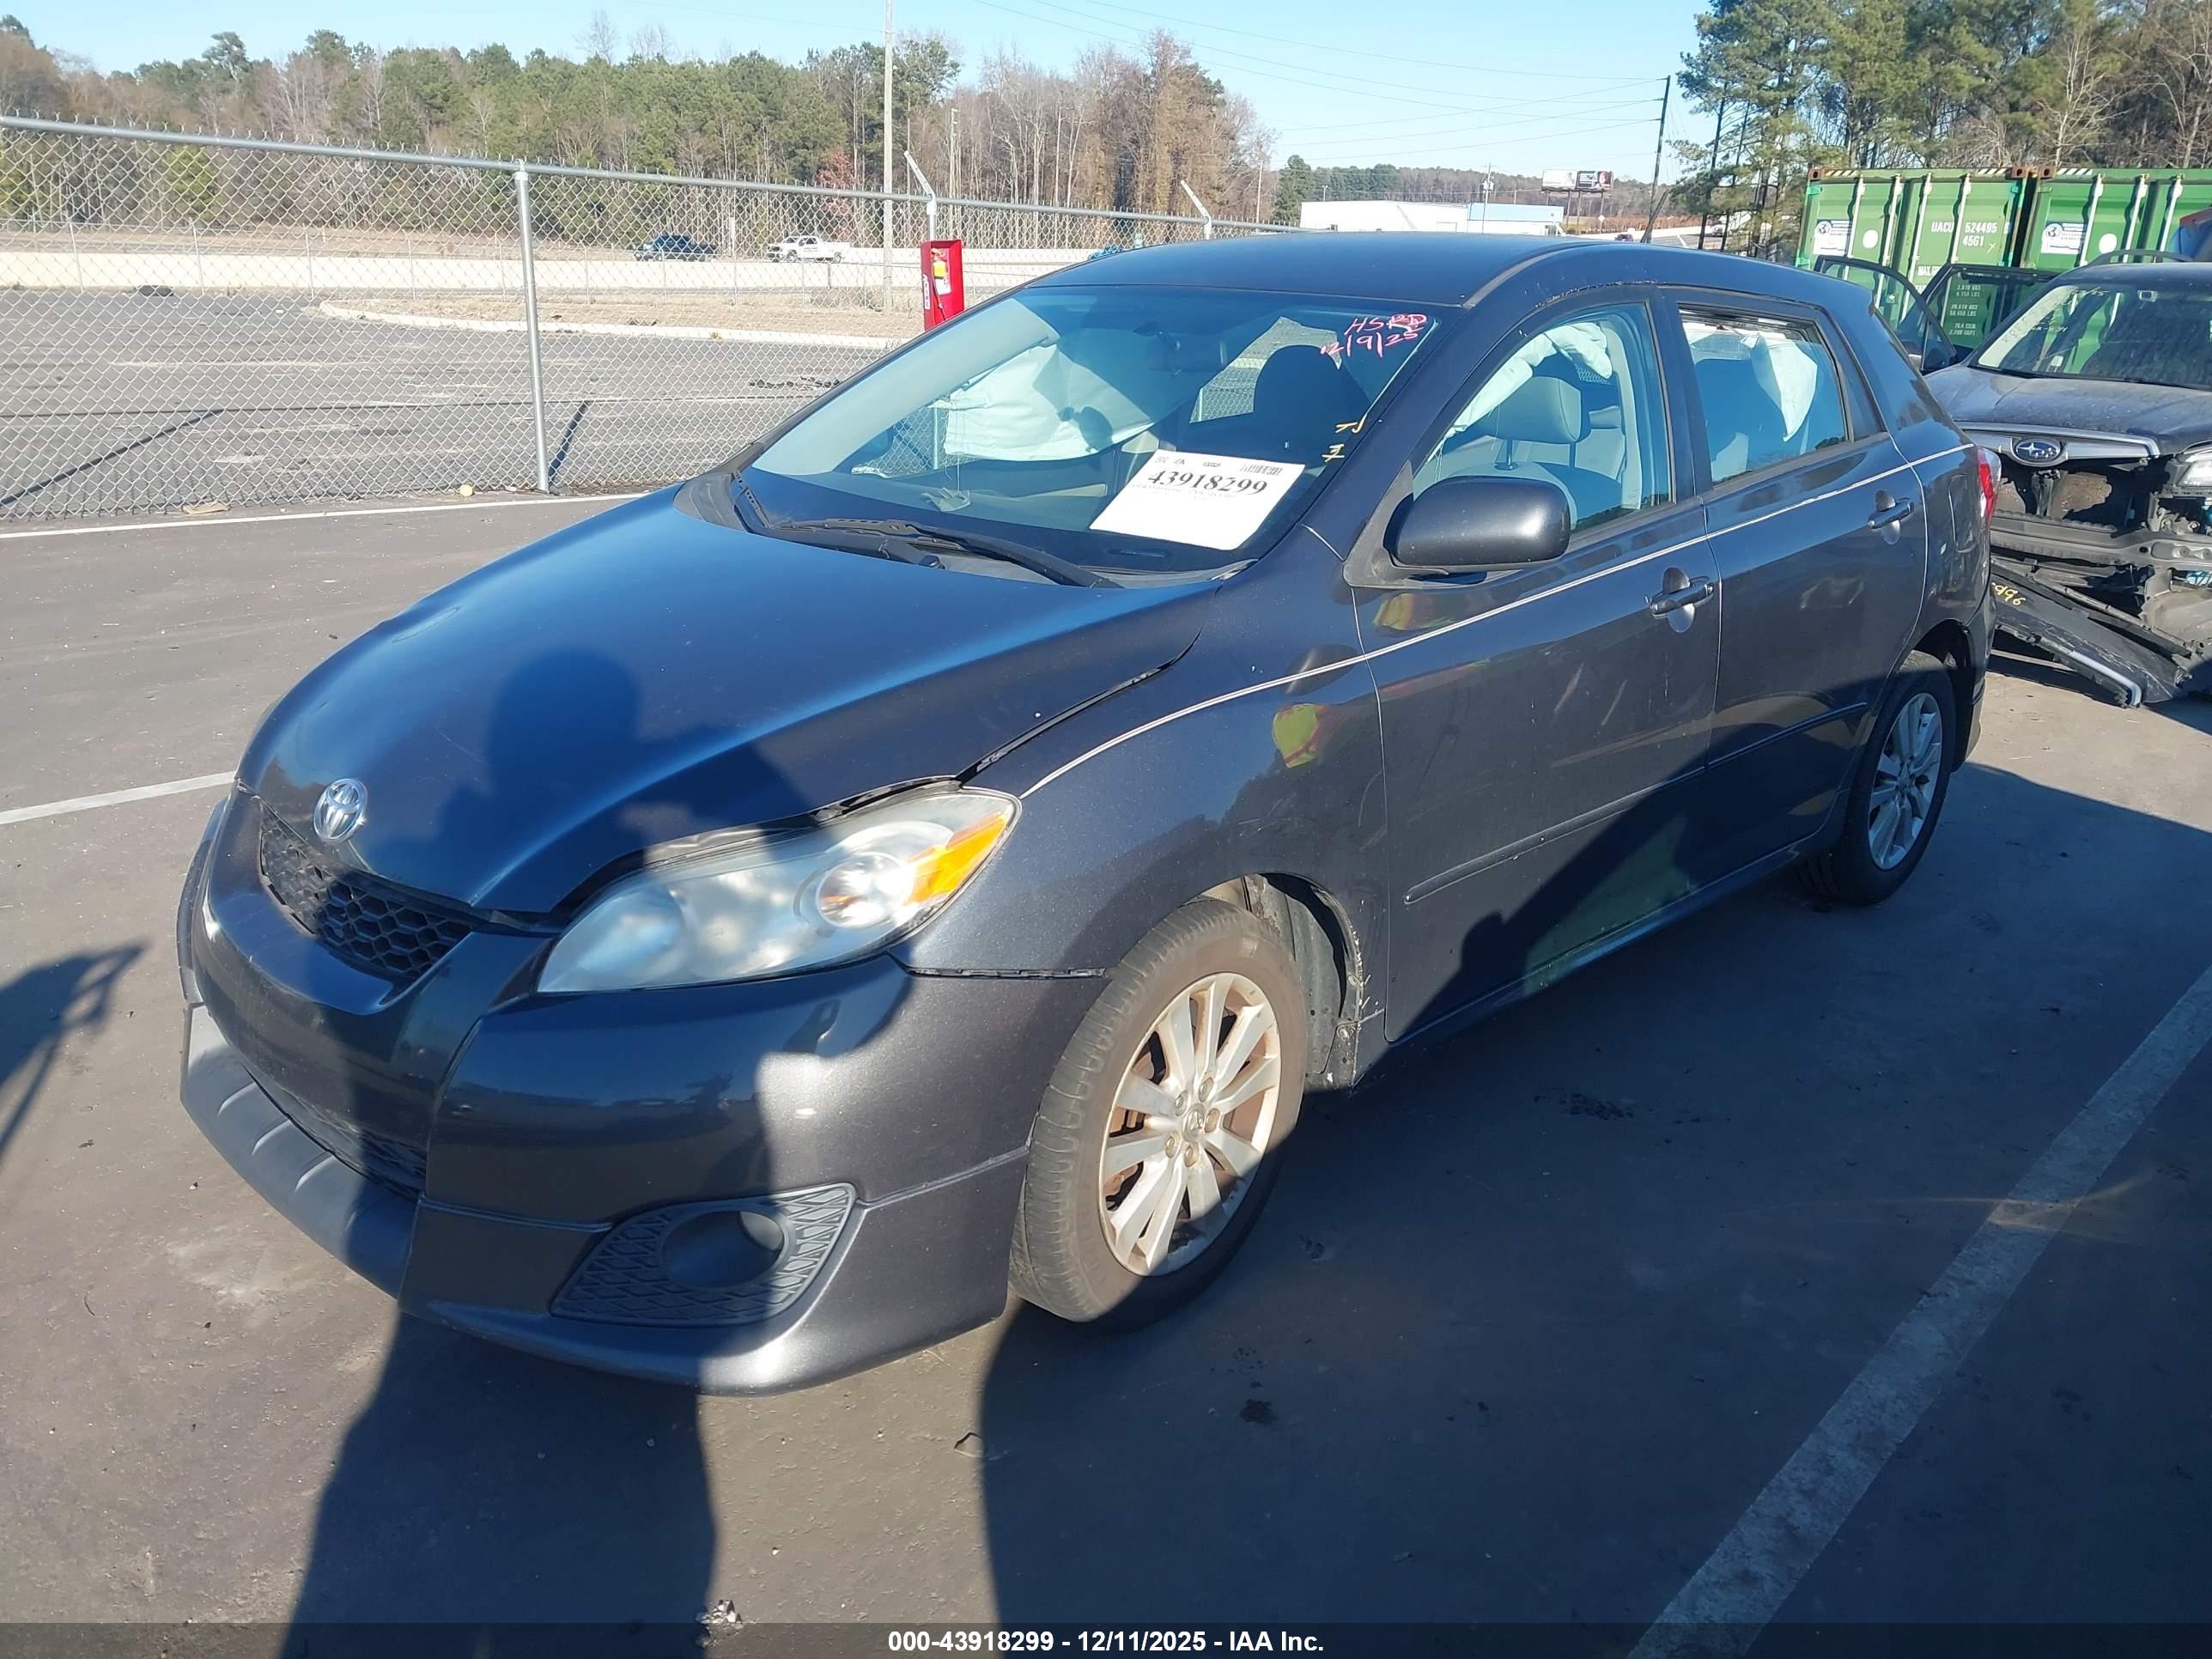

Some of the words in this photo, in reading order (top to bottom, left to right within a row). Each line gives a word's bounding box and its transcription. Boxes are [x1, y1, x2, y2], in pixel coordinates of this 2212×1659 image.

[1931, 222, 1954, 233] UACU
[1965, 222, 1998, 234] 524495
[1148, 470, 1268, 495] 43918299
